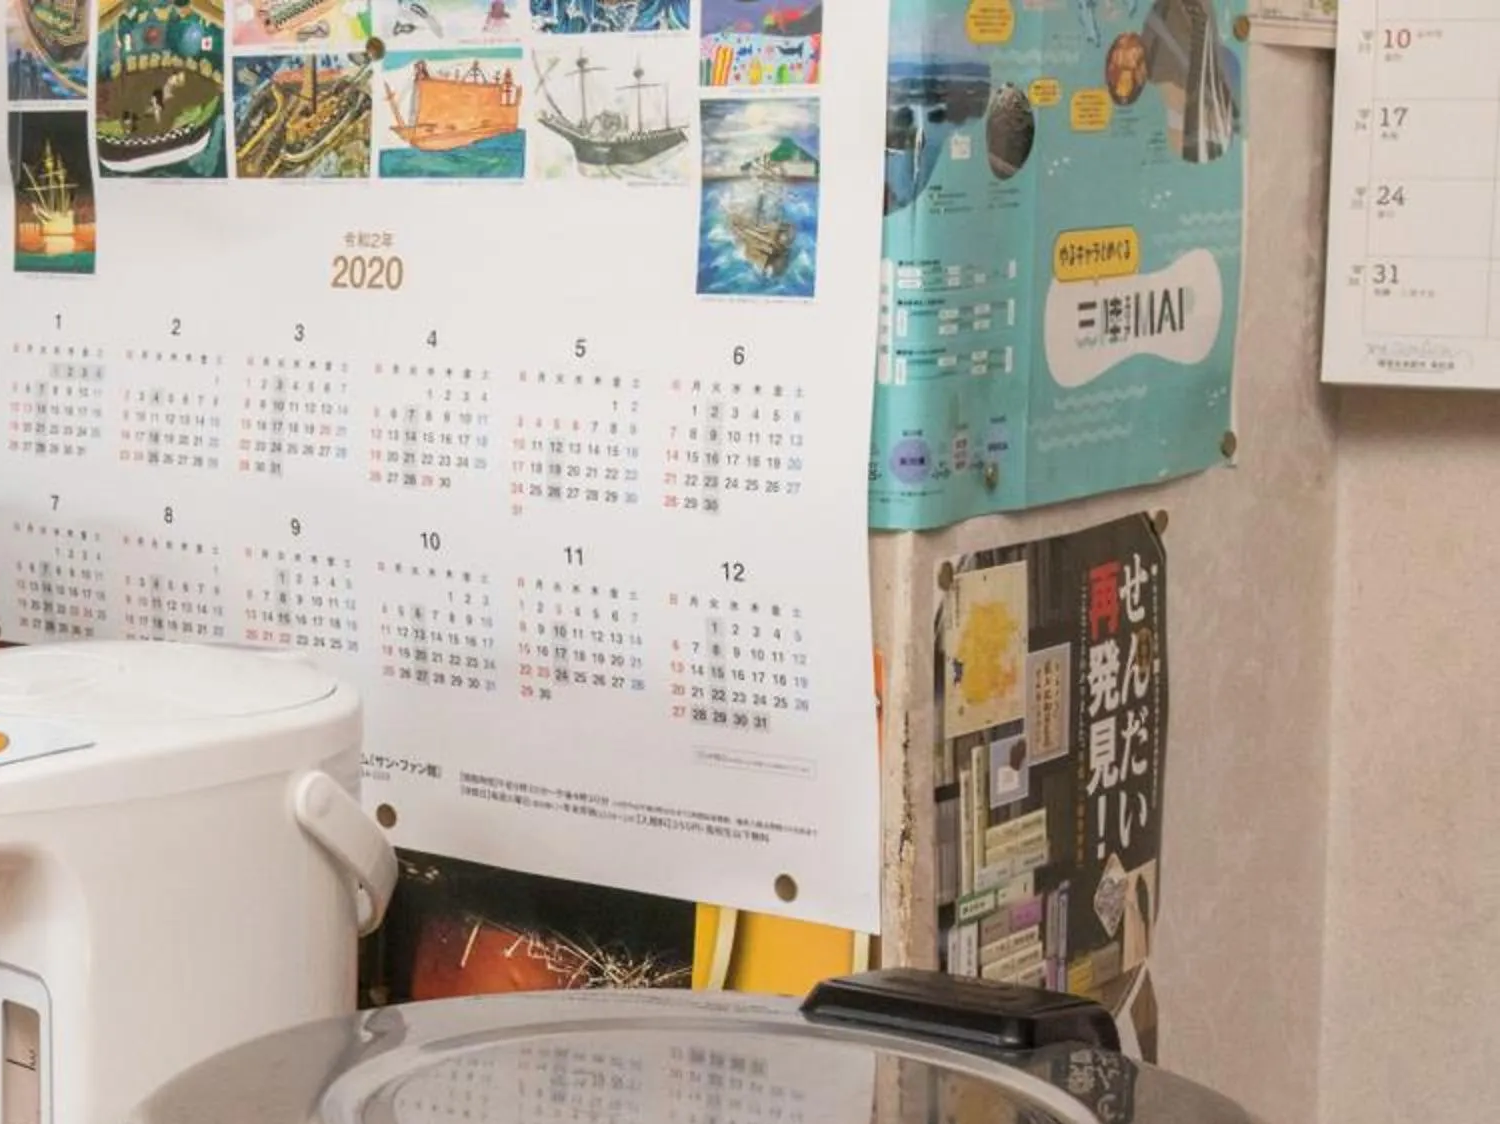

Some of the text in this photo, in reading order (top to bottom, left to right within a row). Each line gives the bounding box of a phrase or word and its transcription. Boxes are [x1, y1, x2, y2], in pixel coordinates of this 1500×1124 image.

[1383, 28, 1412, 49] 10
[1379, 107, 1409, 129] 17
[1376, 186, 1406, 207] 24
[330, 254, 404, 291] 2020
[1372, 263, 1398, 285] 31
[171, 318, 181, 336] 2
[294, 324, 305, 342] 3
[426, 330, 438, 348] 4
[575, 339, 587, 358] 5
[733, 346, 745, 365] 6
[405, 430, 470, 446] 14 17
[531, 438, 562, 454] 11 12
[727, 430, 741, 444] 10
[747, 430, 761, 445] 11
[769, 433, 782, 447] 12
[439, 454, 450, 468] 23
[686, 450, 700, 464] 15
[706, 451, 719, 466] 16
[726, 452, 740, 467] 17
[747, 454, 760, 469] 18
[767, 456, 780, 471] 19
[567, 464, 598, 479] 20 21
[439, 476, 451, 489] 30
[684, 473, 698, 487] 22
[705, 474, 718, 489] 23
[725, 476, 738, 490] 24
[745, 478, 759, 492] 25
[766, 479, 780, 494] 26
[51, 495, 60, 511] 7
[567, 486, 618, 503] 27 29
[684, 495, 697, 510] 29
[704, 498, 718, 512] 30
[164, 507, 173, 524] 8
[291, 518, 301, 535] 9
[421, 532, 441, 551] 10
[563, 546, 584, 565] 11
[721, 561, 746, 582] 12
[397, 626, 477, 648] 12 14 15 16
[554, 625, 566, 638] 10
[572, 626, 584, 640] 11
[591, 630, 603, 643] 12
[610, 632, 623, 645] 13
[431, 651, 478, 668] 21 22 23
[536, 644, 549, 658] 16
[555, 646, 568, 660] 17
[573, 649, 586, 663] 18
[592, 652, 605, 665] 19
[611, 653, 624, 667] 20
[751, 648, 764, 662] 10
[771, 650, 784, 664] 11
[434, 672, 480, 689] 28 29 30
[555, 668, 568, 682] 24
[574, 671, 586, 684] 25
[593, 673, 606, 687] 26
[612, 676, 624, 689] 27
[691, 663, 704, 677] 14
[711, 666, 724, 680] 15
[731, 668, 745, 682] 16
[751, 671, 765, 684] 17
[773, 674, 787, 687] 18
[539, 687, 552, 701] 30
[691, 685, 705, 699] 21
[712, 689, 725, 702] 22
[733, 691, 746, 704] 23
[753, 693, 766, 706] 24
[774, 695, 787, 709] 25
[1120, 553, 1150, 849] せんだい
[693, 708, 707, 721] 28
[713, 710, 726, 724] 29
[734, 714, 748, 727] 30
[753, 715, 767, 729] 31
